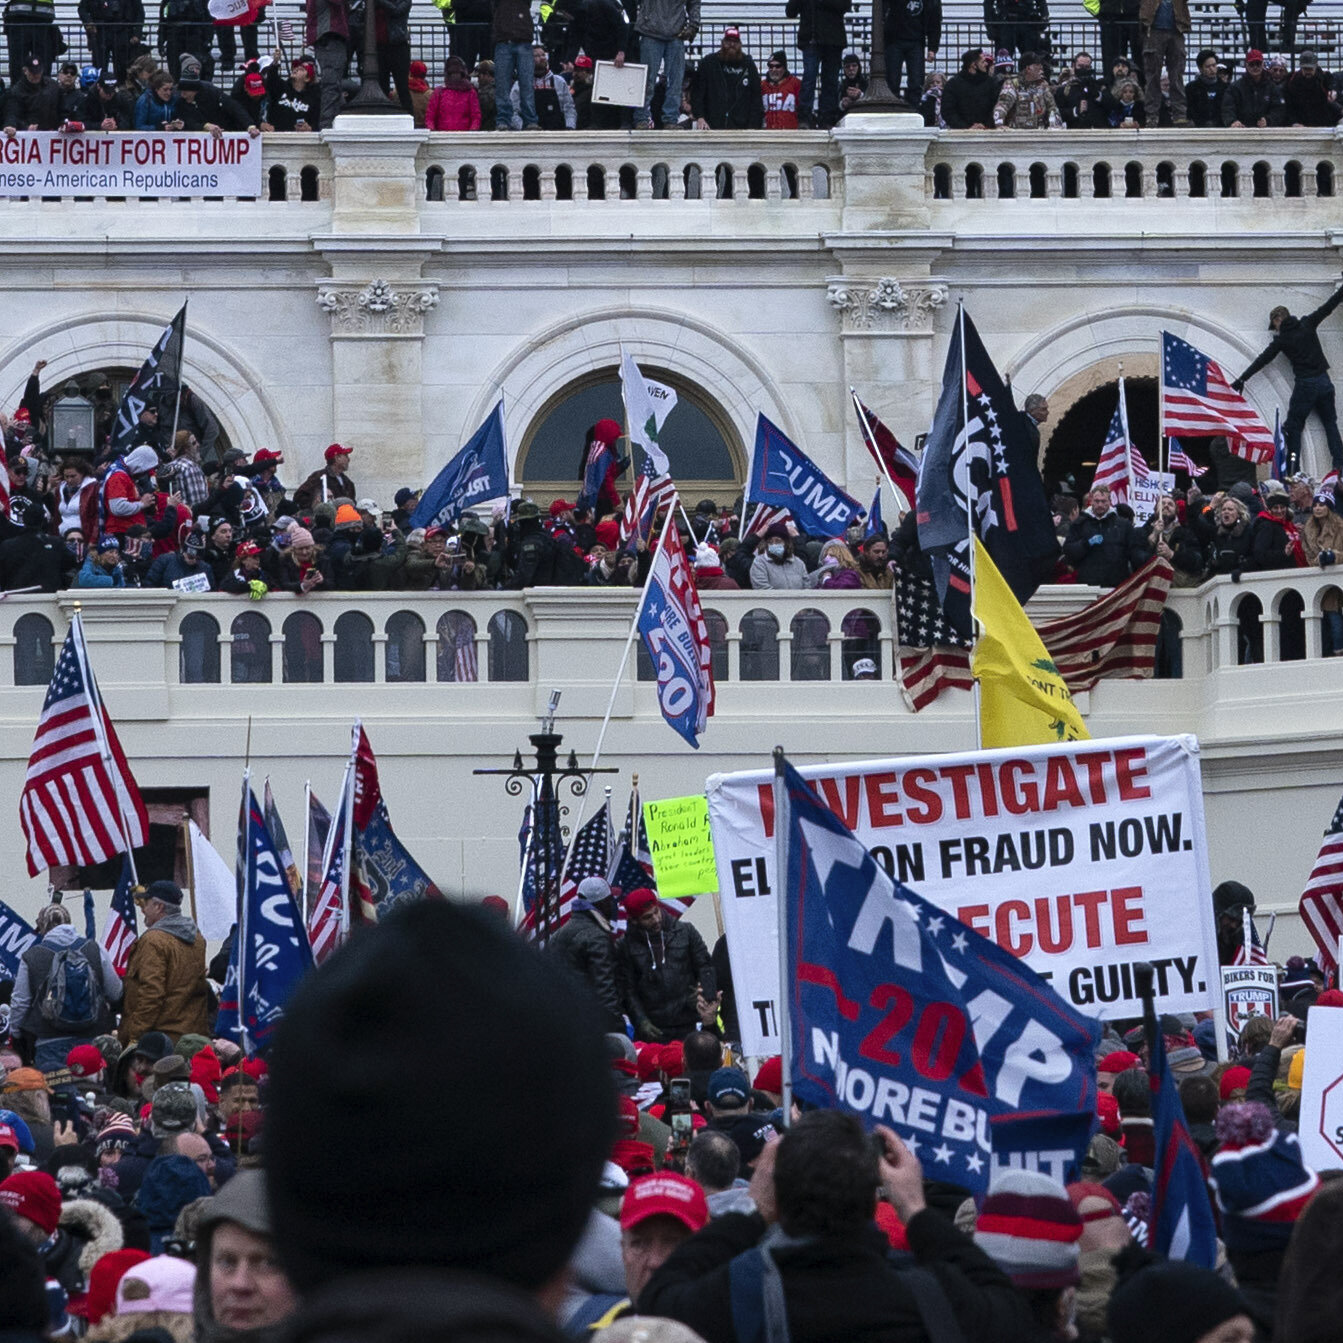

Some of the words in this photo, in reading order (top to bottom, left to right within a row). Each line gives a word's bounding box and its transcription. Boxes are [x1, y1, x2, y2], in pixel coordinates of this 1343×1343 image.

[49, 138, 115, 165] FIGHT
[121, 138, 167, 165] FOR
[172, 138, 251, 165] TRUMP
[122, 169, 219, 190] Republicans
[758, 745, 1151, 838] IVESTIGATE
[939, 826, 1074, 880] FRAUD
[1090, 812, 1193, 862] NOW.
[1069, 955, 1207, 1006] GUITY.
[1225, 971, 1255, 984] BIKERS
[1257, 971, 1275, 984] FOR
[1231, 992, 1270, 1002] TRUMP
